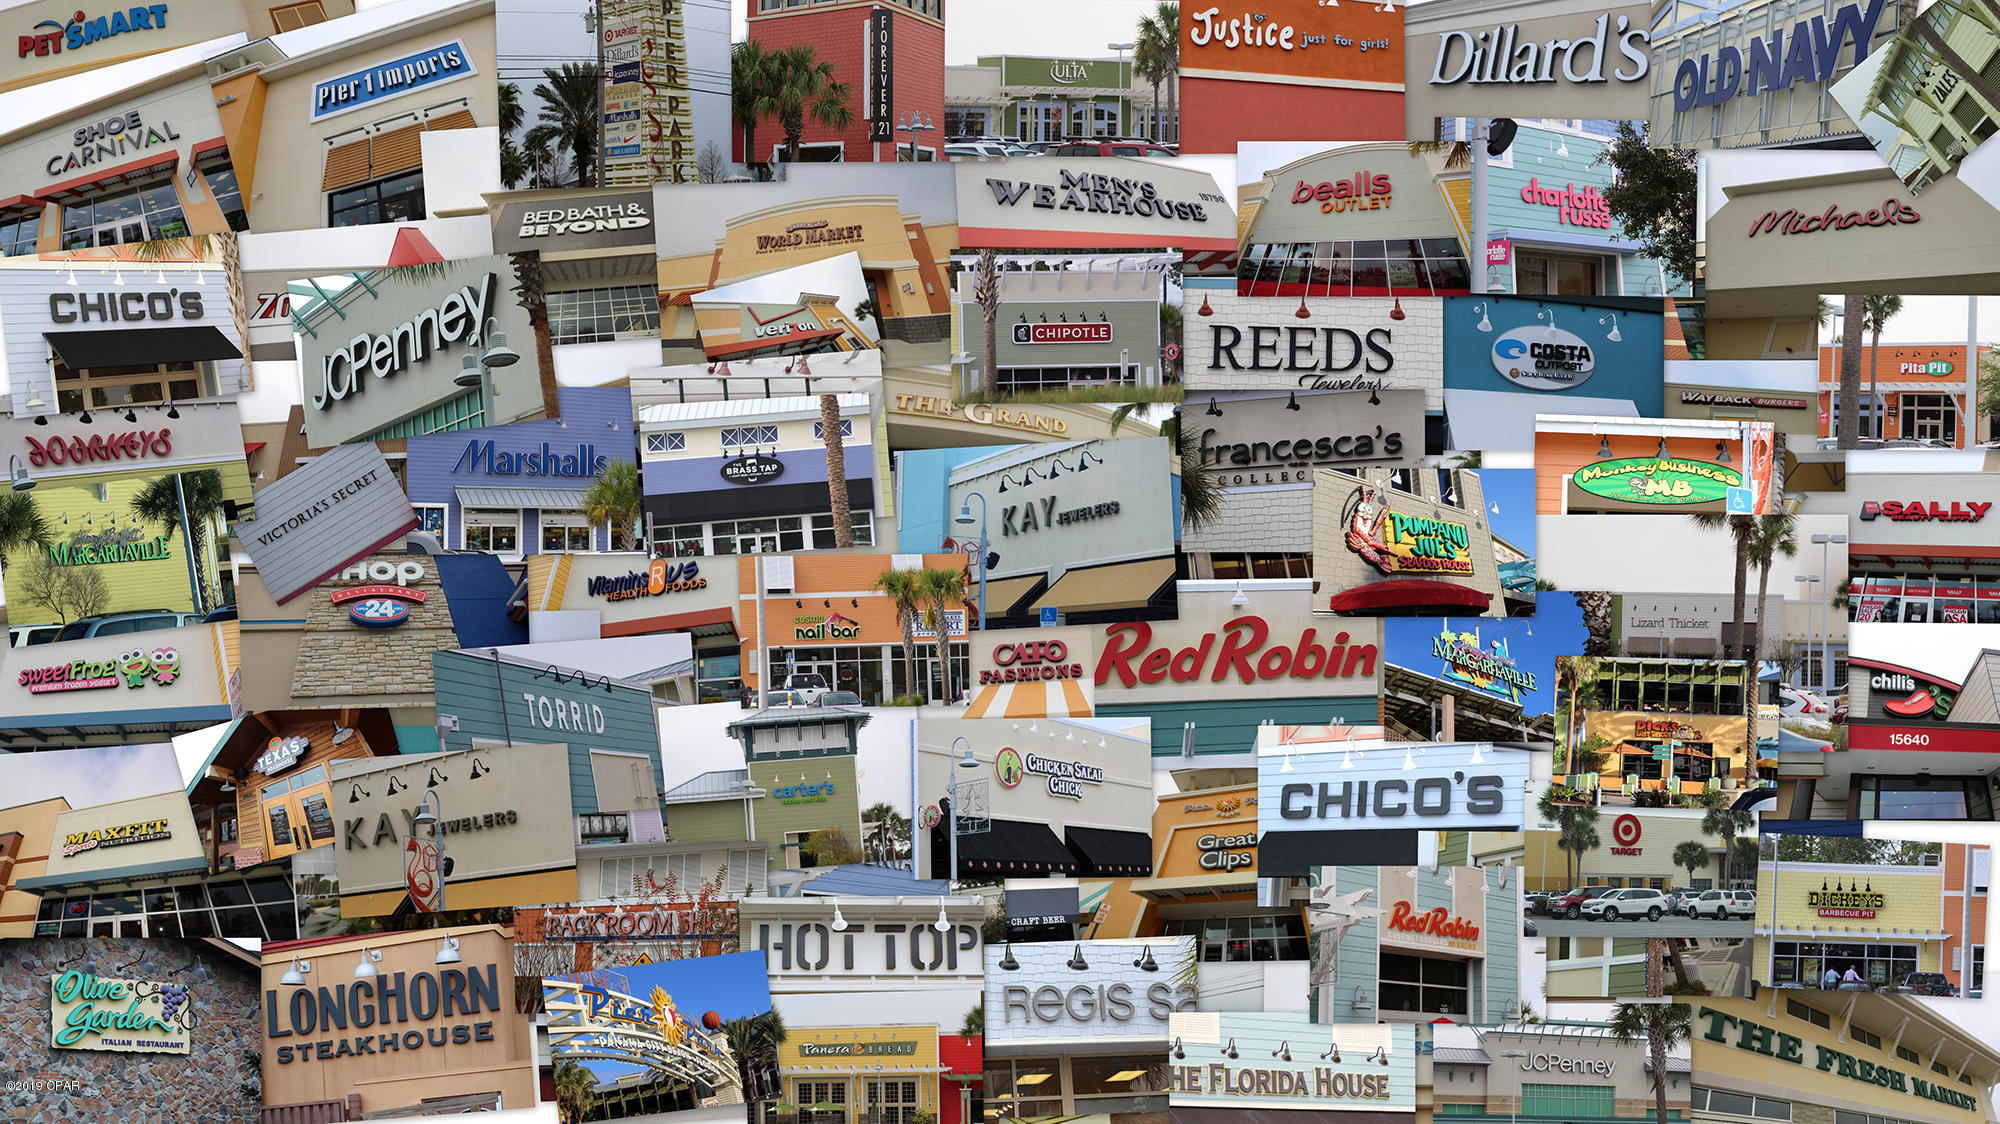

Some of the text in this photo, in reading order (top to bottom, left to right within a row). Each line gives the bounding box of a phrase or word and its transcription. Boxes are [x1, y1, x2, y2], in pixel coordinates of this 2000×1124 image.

[18, 4, 168, 58] PETSMART
[660, 0, 679, 85] PIER
[1191, 7, 1389, 52] Justice just for girls!
[606, 45, 639, 62] Dillard's
[1428, 13, 1651, 87] Dillard's
[1673, 0, 1887, 113] OLD NAVY
[318, 48, 463, 108] Pier 1 Imports
[879, 15, 889, 135] FOREVER 21
[1055, 64, 1087, 79] ULTA
[1932, 69, 1959, 104] ZALES
[73, 110, 142, 147] SHOE
[667, 96, 686, 184] PARK
[46, 121, 180, 175] CARNIVAL
[1059, 168, 1157, 200] MEN'S
[1291, 170, 1391, 205] bealls
[1520, 177, 1611, 212] charlotte
[985, 177, 1209, 223] WEARHOUSE
[1198, 191, 1225, 205] 15750
[1320, 195, 1392, 213] OUTLET
[518, 216, 650, 238] BEYOND
[522, 202, 646, 226] BED BATH &
[1560, 207, 1612, 229] russe
[1749, 198, 1921, 238] Michaels
[756, 225, 862, 250] WORLD MARKET
[50, 288, 204, 323] CHICO'S
[754, 316, 816, 339] verizon
[1035, 326, 1108, 340] CHIPOTLE
[311, 272, 497, 411] JCPenney
[1207, 324, 1394, 374] REEDS
[1530, 343, 1591, 361] COSTA
[1535, 360, 1583, 370] OUTPOST
[1900, 362, 1947, 374] Pita Pit
[964, 402, 1068, 435] GRAND
[25, 428, 172, 467] JOURNEYS
[1199, 424, 1404, 465] francesca's
[452, 439, 607, 477] Marshalls
[726, 465, 758, 475] BRASS
[759, 464, 778, 473] TAP
[1218, 470, 1305, 487] COLLEC
[1582, 460, 1740, 487] Monkey Business
[1644, 478, 1694, 497] MB
[258, 469, 379, 547] VICTORIA'S SECRET
[1002, 496, 1120, 536] KAY JEWELERS
[1881, 500, 1992, 517] SALLY
[1891, 514, 1981, 522] BEAUTY SUPPLY
[1390, 513, 1468, 549] POMPANO
[49, 536, 171, 566] MARGARITAVILLE
[1411, 537, 1457, 559] JOE'S
[330, 562, 424, 586] HOP
[1398, 555, 1470, 571] SEAFOOD HOUSE
[338, 588, 420, 598] RESTAURANT
[588, 570, 649, 597] Vitamins
[606, 578, 706, 601] HEALTH FOODS
[365, 600, 395, 618] 24
[794, 615, 824, 624] cosmo
[1860, 613, 1871, 621] 20
[794, 623, 861, 641] nail bar
[1631, 617, 1709, 629] Lizard Thicket
[992, 639, 1068, 667] CATO
[1094, 615, 1378, 688] Red Robin
[1432, 637, 1538, 690] MARGARITAVILLE
[18, 659, 116, 684] sweetFrog
[979, 663, 1083, 685] FASHIONS
[1871, 672, 1915, 692] chili's
[32, 679, 116, 692] premium frozen yogurt
[523, 693, 605, 735] TORRID
[1636, 720, 1679, 732] DICK'S
[1889, 733, 1930, 746] 15640
[257, 741, 300, 769] TEXAS
[1027, 754, 1104, 781] CHICKEN SALAD
[774, 780, 834, 798] carter's
[1050, 777, 1083, 798] CHICK
[1281, 771, 1503, 820] CHICO'S
[64, 819, 168, 847] MAXFIT
[343, 806, 421, 850] KAY
[1198, 832, 1256, 848] Great
[63, 832, 171, 856] Sports NUTRITION
[1610, 847, 1643, 856] TARGET
[1200, 851, 1251, 870] Clips
[1809, 892, 1883, 908] DICKEY'S
[1820, 909, 1860, 917] BARBECUE
[549, 915, 600, 936] RACK
[605, 912, 672, 935] ROOM
[1010, 914, 1066, 926] CRAFT BEER
[1388, 900, 1479, 941] Red Robin
[761, 923, 978, 971] HOT TOP
[55, 969, 129, 1003] Olive
[265, 963, 501, 1038] LONGHORN
[56, 1000, 174, 1046] Garden
[578, 984, 658, 1027] Pier
[680, 1019, 726, 1063] Park
[101, 1037, 185, 1050] ITALIAN RESTAURANT
[277, 1021, 494, 1065] STEAKHOUSE
[802, 1042, 912, 1055] Panera BREAD
[1520, 1053, 1616, 1078] JCPenney
[1699, 1005, 1978, 1112] THE FRESH MARKET
[1207, 1062, 1310, 1097] FLORIDA
[1314, 1066, 1390, 1100] HOUSE
